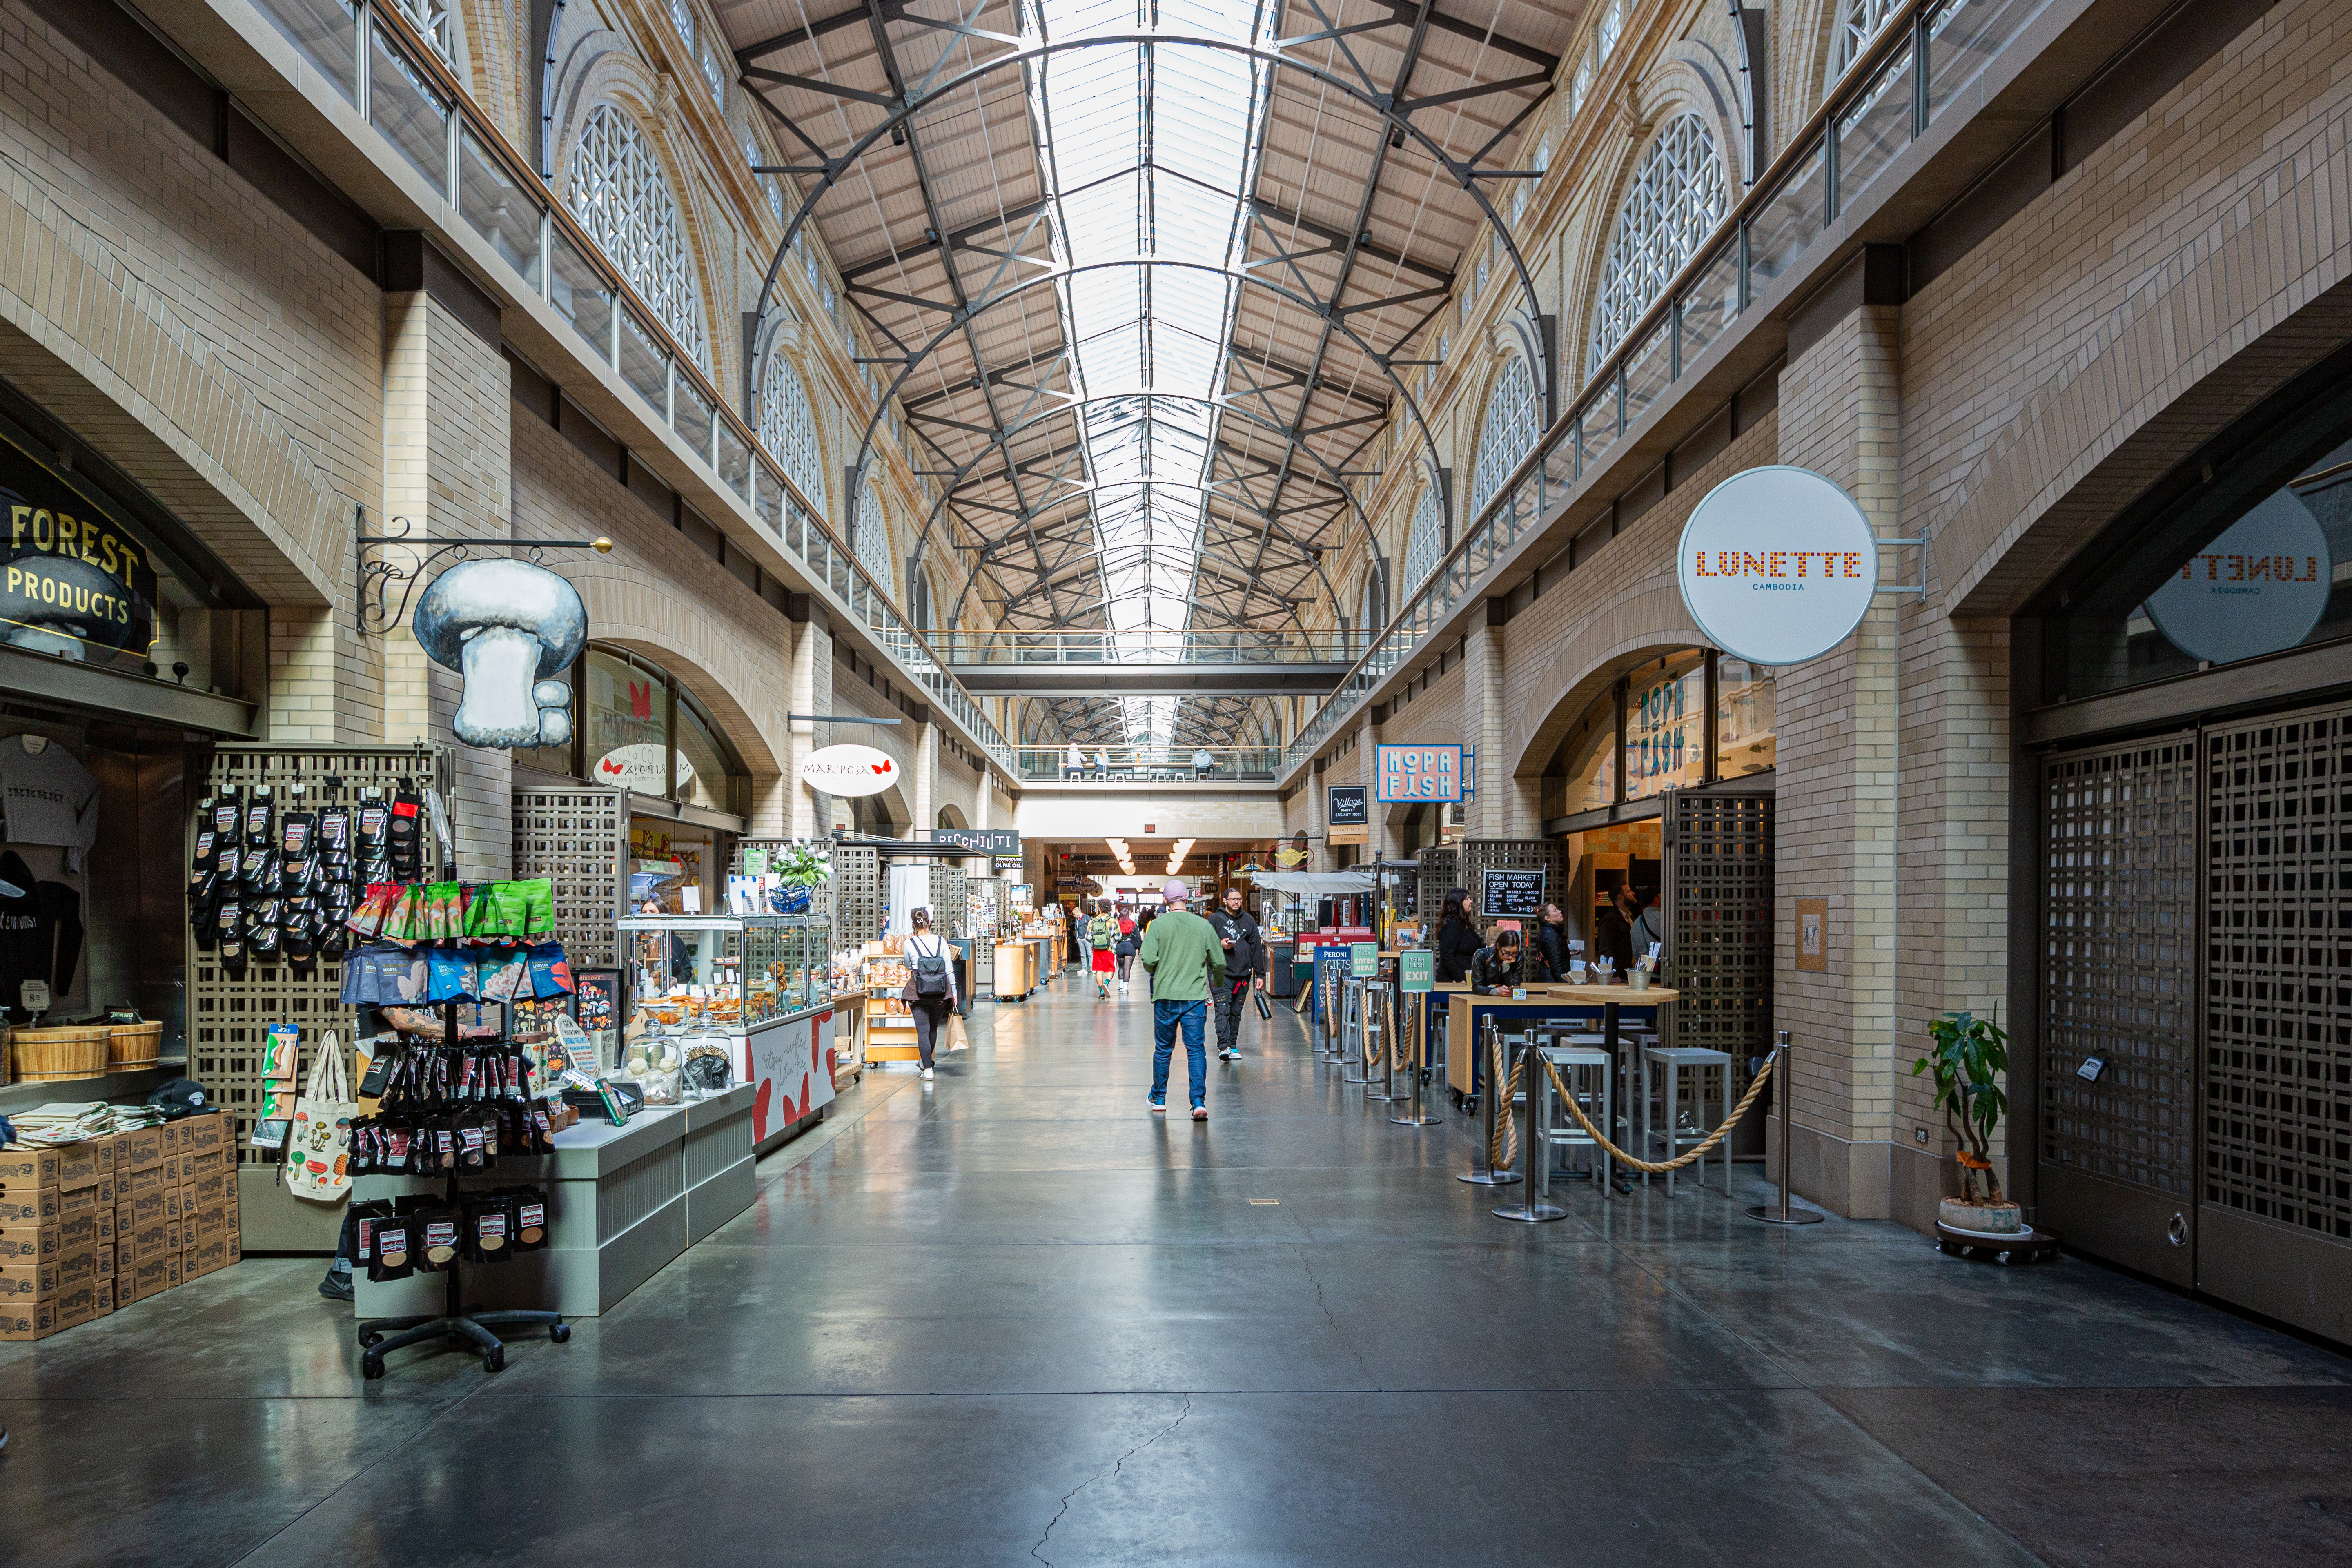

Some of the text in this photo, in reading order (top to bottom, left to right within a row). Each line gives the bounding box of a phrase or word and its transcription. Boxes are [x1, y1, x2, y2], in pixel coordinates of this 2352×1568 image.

[11, 505, 139, 590] FOREST
[1697, 552, 1861, 577] LUNETTE
[7, 566, 128, 624] PRODUCTS
[1641, 677, 1684, 733] NOPA
[1388, 751, 1453, 773] NOPA
[1641, 726, 1684, 780] FISH
[804, 764, 870, 775] MARIPOSA
[1388, 777, 1453, 797] FISH
[1333, 797, 1363, 808] Village
[1405, 971, 1429, 982] EXIT
